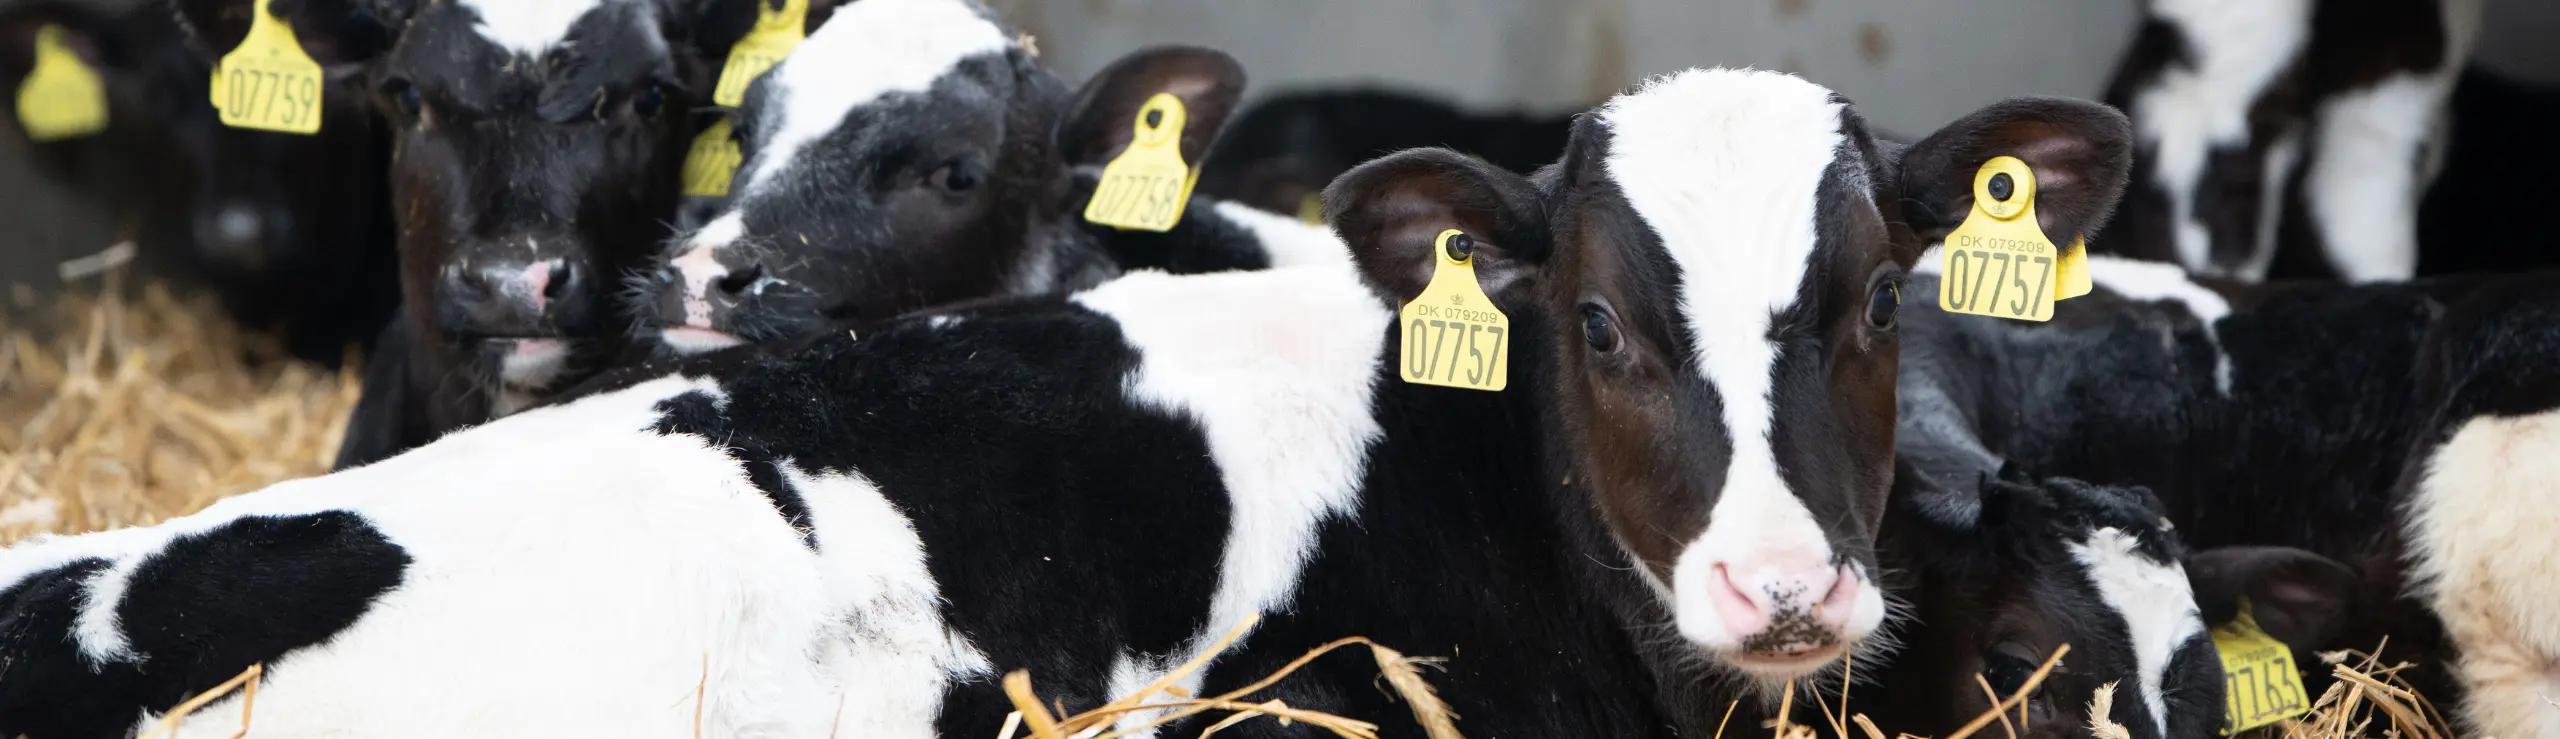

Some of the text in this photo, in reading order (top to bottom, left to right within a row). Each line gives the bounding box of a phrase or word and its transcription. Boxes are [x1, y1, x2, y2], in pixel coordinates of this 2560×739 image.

[228, 68, 316, 126] 07759
[1094, 174, 1178, 226] 07758
[1961, 235, 2045, 254] DK 079209
[1948, 249, 2052, 317] 07757
[1418, 304, 1498, 324] DK 079209
[1409, 318, 1504, 387] 07757
